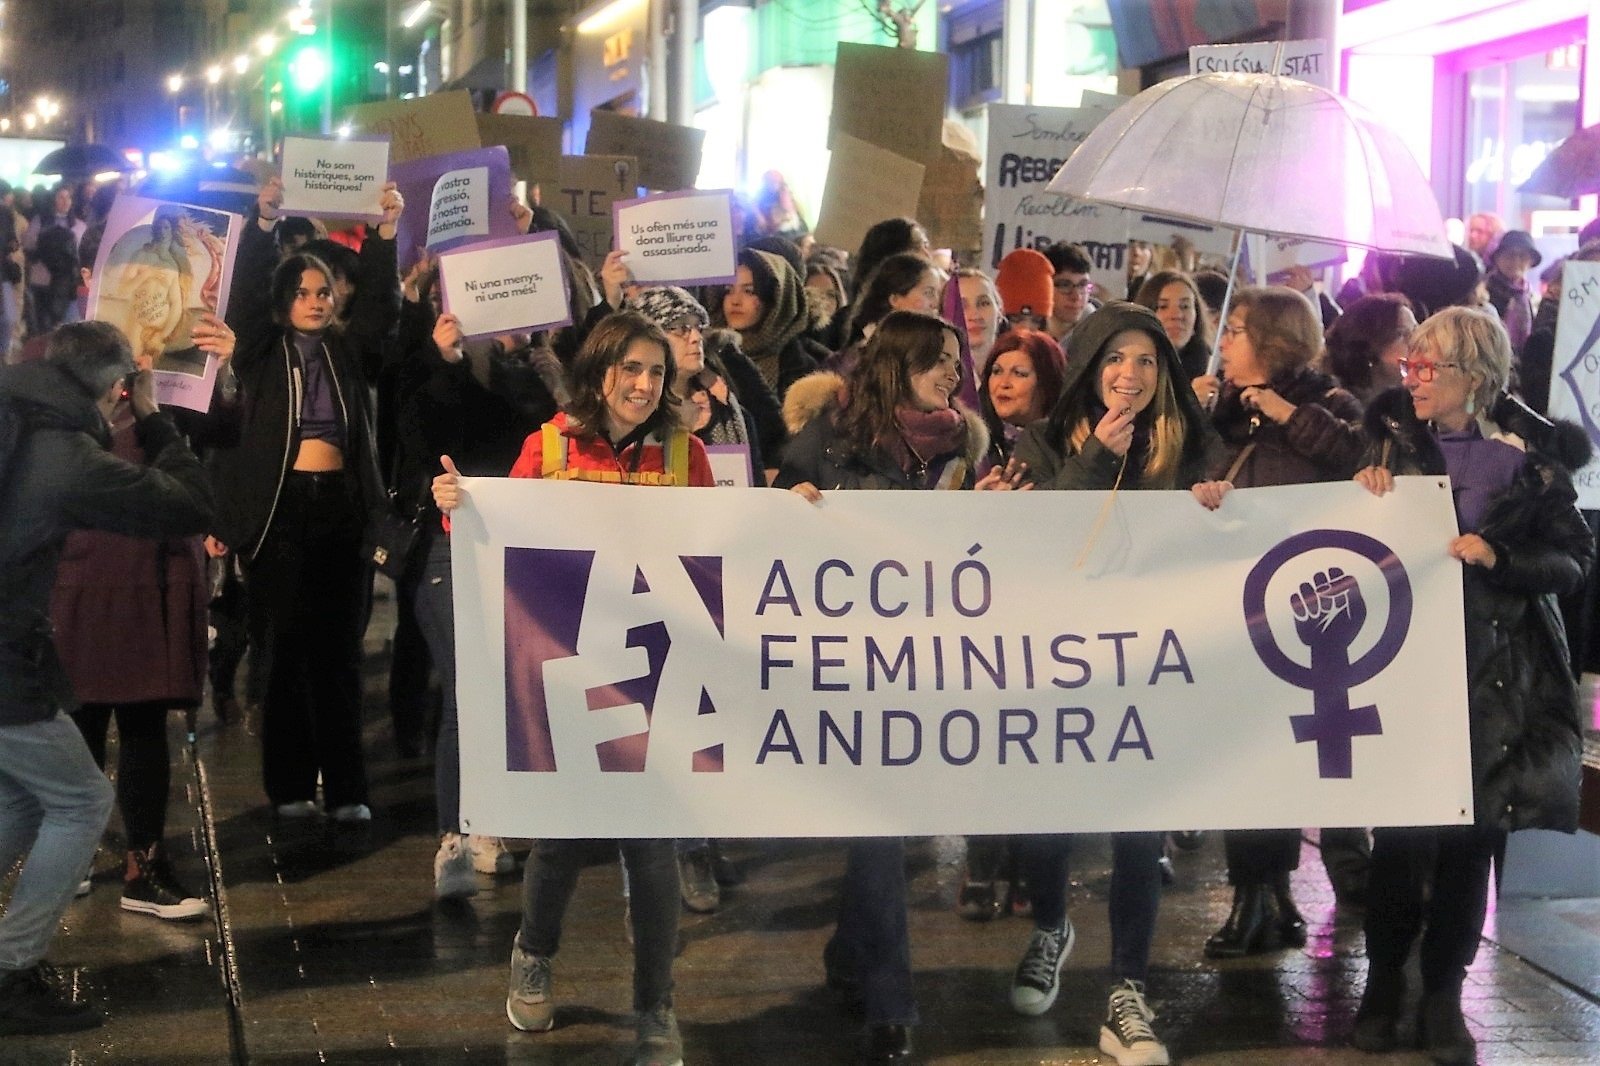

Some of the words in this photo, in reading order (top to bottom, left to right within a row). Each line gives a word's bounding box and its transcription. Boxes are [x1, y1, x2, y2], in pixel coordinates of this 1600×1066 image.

[316, 159, 332, 169] No
[333, 162, 355, 170] som
[294, 168, 351, 182] histèriques,
[304, 180, 363, 193] històriques!
[631, 224, 645, 234] Us
[673, 219, 695, 230] més
[697, 220, 718, 228] una
[635, 235, 664, 245] dona
[666, 233, 694, 243] lliure
[695, 232, 716, 244] que
[642, 244, 711, 257] assassinada.
[464, 280, 477, 291] Ni
[480, 280, 501, 289] una
[503, 273, 543, 286] menys,
[475, 291, 486, 302] ni
[487, 291, 509, 300] una
[511, 283, 537, 296] més!
[754, 542, 992, 618] ACCIÓ
[760, 628, 1196, 692] FEMINISTA
[755, 704, 1155, 767] ANDORRA
